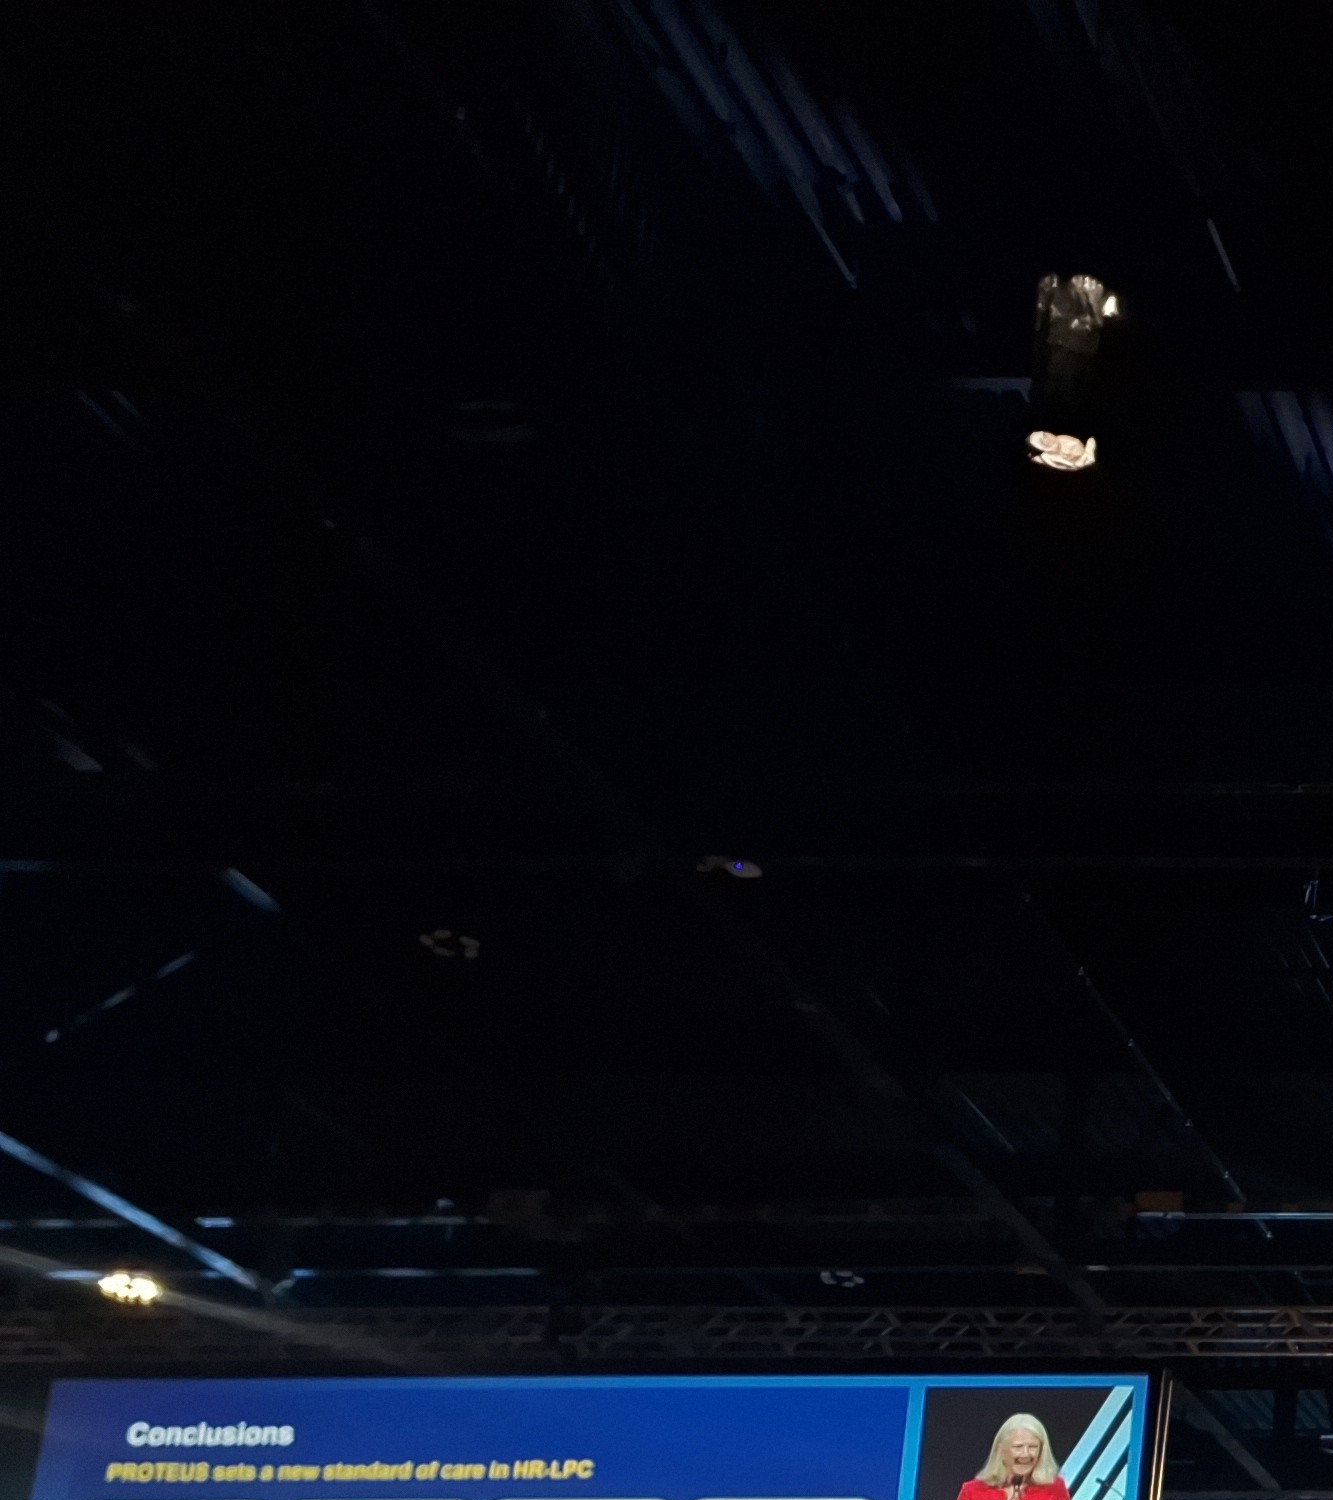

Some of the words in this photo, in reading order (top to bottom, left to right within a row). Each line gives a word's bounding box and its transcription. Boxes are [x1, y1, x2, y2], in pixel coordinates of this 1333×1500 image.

[126, 1421, 295, 1447] Conclusions
[105, 1460, 209, 1484] PROTEUS
[212, 1463, 256, 1482] sets
[260, 1468, 273, 1482] a
[278, 1465, 320, 1482] new
[323, 1461, 411, 1482] standard
[415, 1461, 442, 1481] of
[444, 1464, 485, 1481] care
[489, 1461, 509, 1480] in
[514, 1460, 594, 1480] HR-LPC
